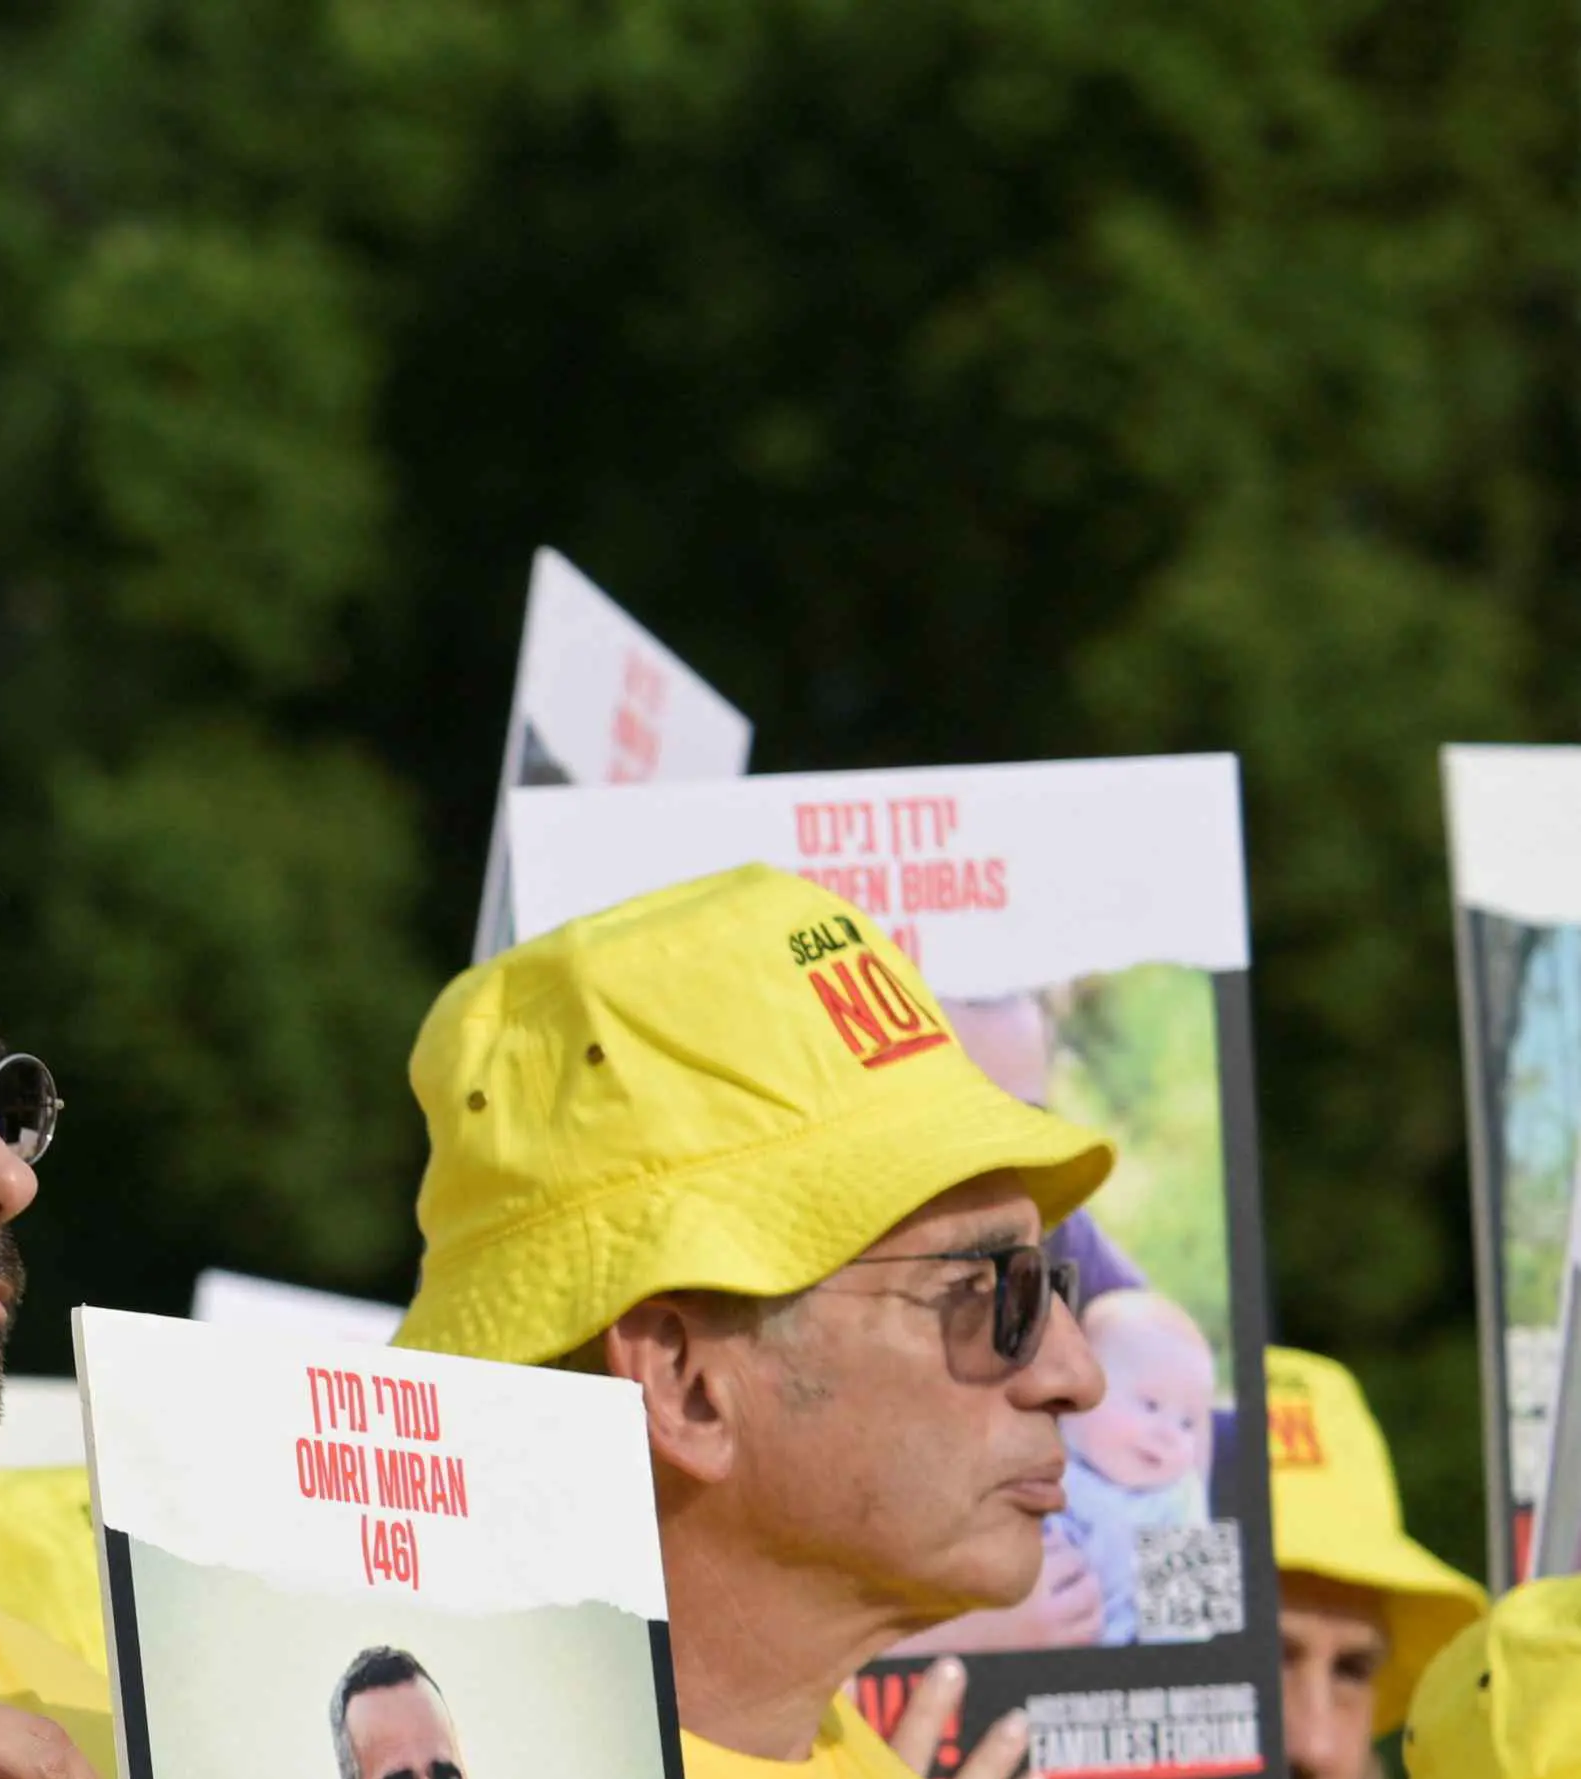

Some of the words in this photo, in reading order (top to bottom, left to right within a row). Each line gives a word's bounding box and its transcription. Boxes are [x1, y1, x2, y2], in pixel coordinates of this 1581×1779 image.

[795, 801, 875, 857] ביבס
[901, 858, 1007, 912] BIBAS
[789, 922, 847, 966] SEAL
[808, 951, 924, 1056] NO
[306, 1367, 368, 1434] מירן
[371, 1375, 441, 1442] עמרי
[296, 1437, 370, 1506] OMRI
[374, 1447, 469, 1518] MIRAN
[361, 1514, 419, 1591] (46)
[1029, 1722, 1154, 1772] FAMILIES
[1157, 1717, 1258, 1767] FORUM
